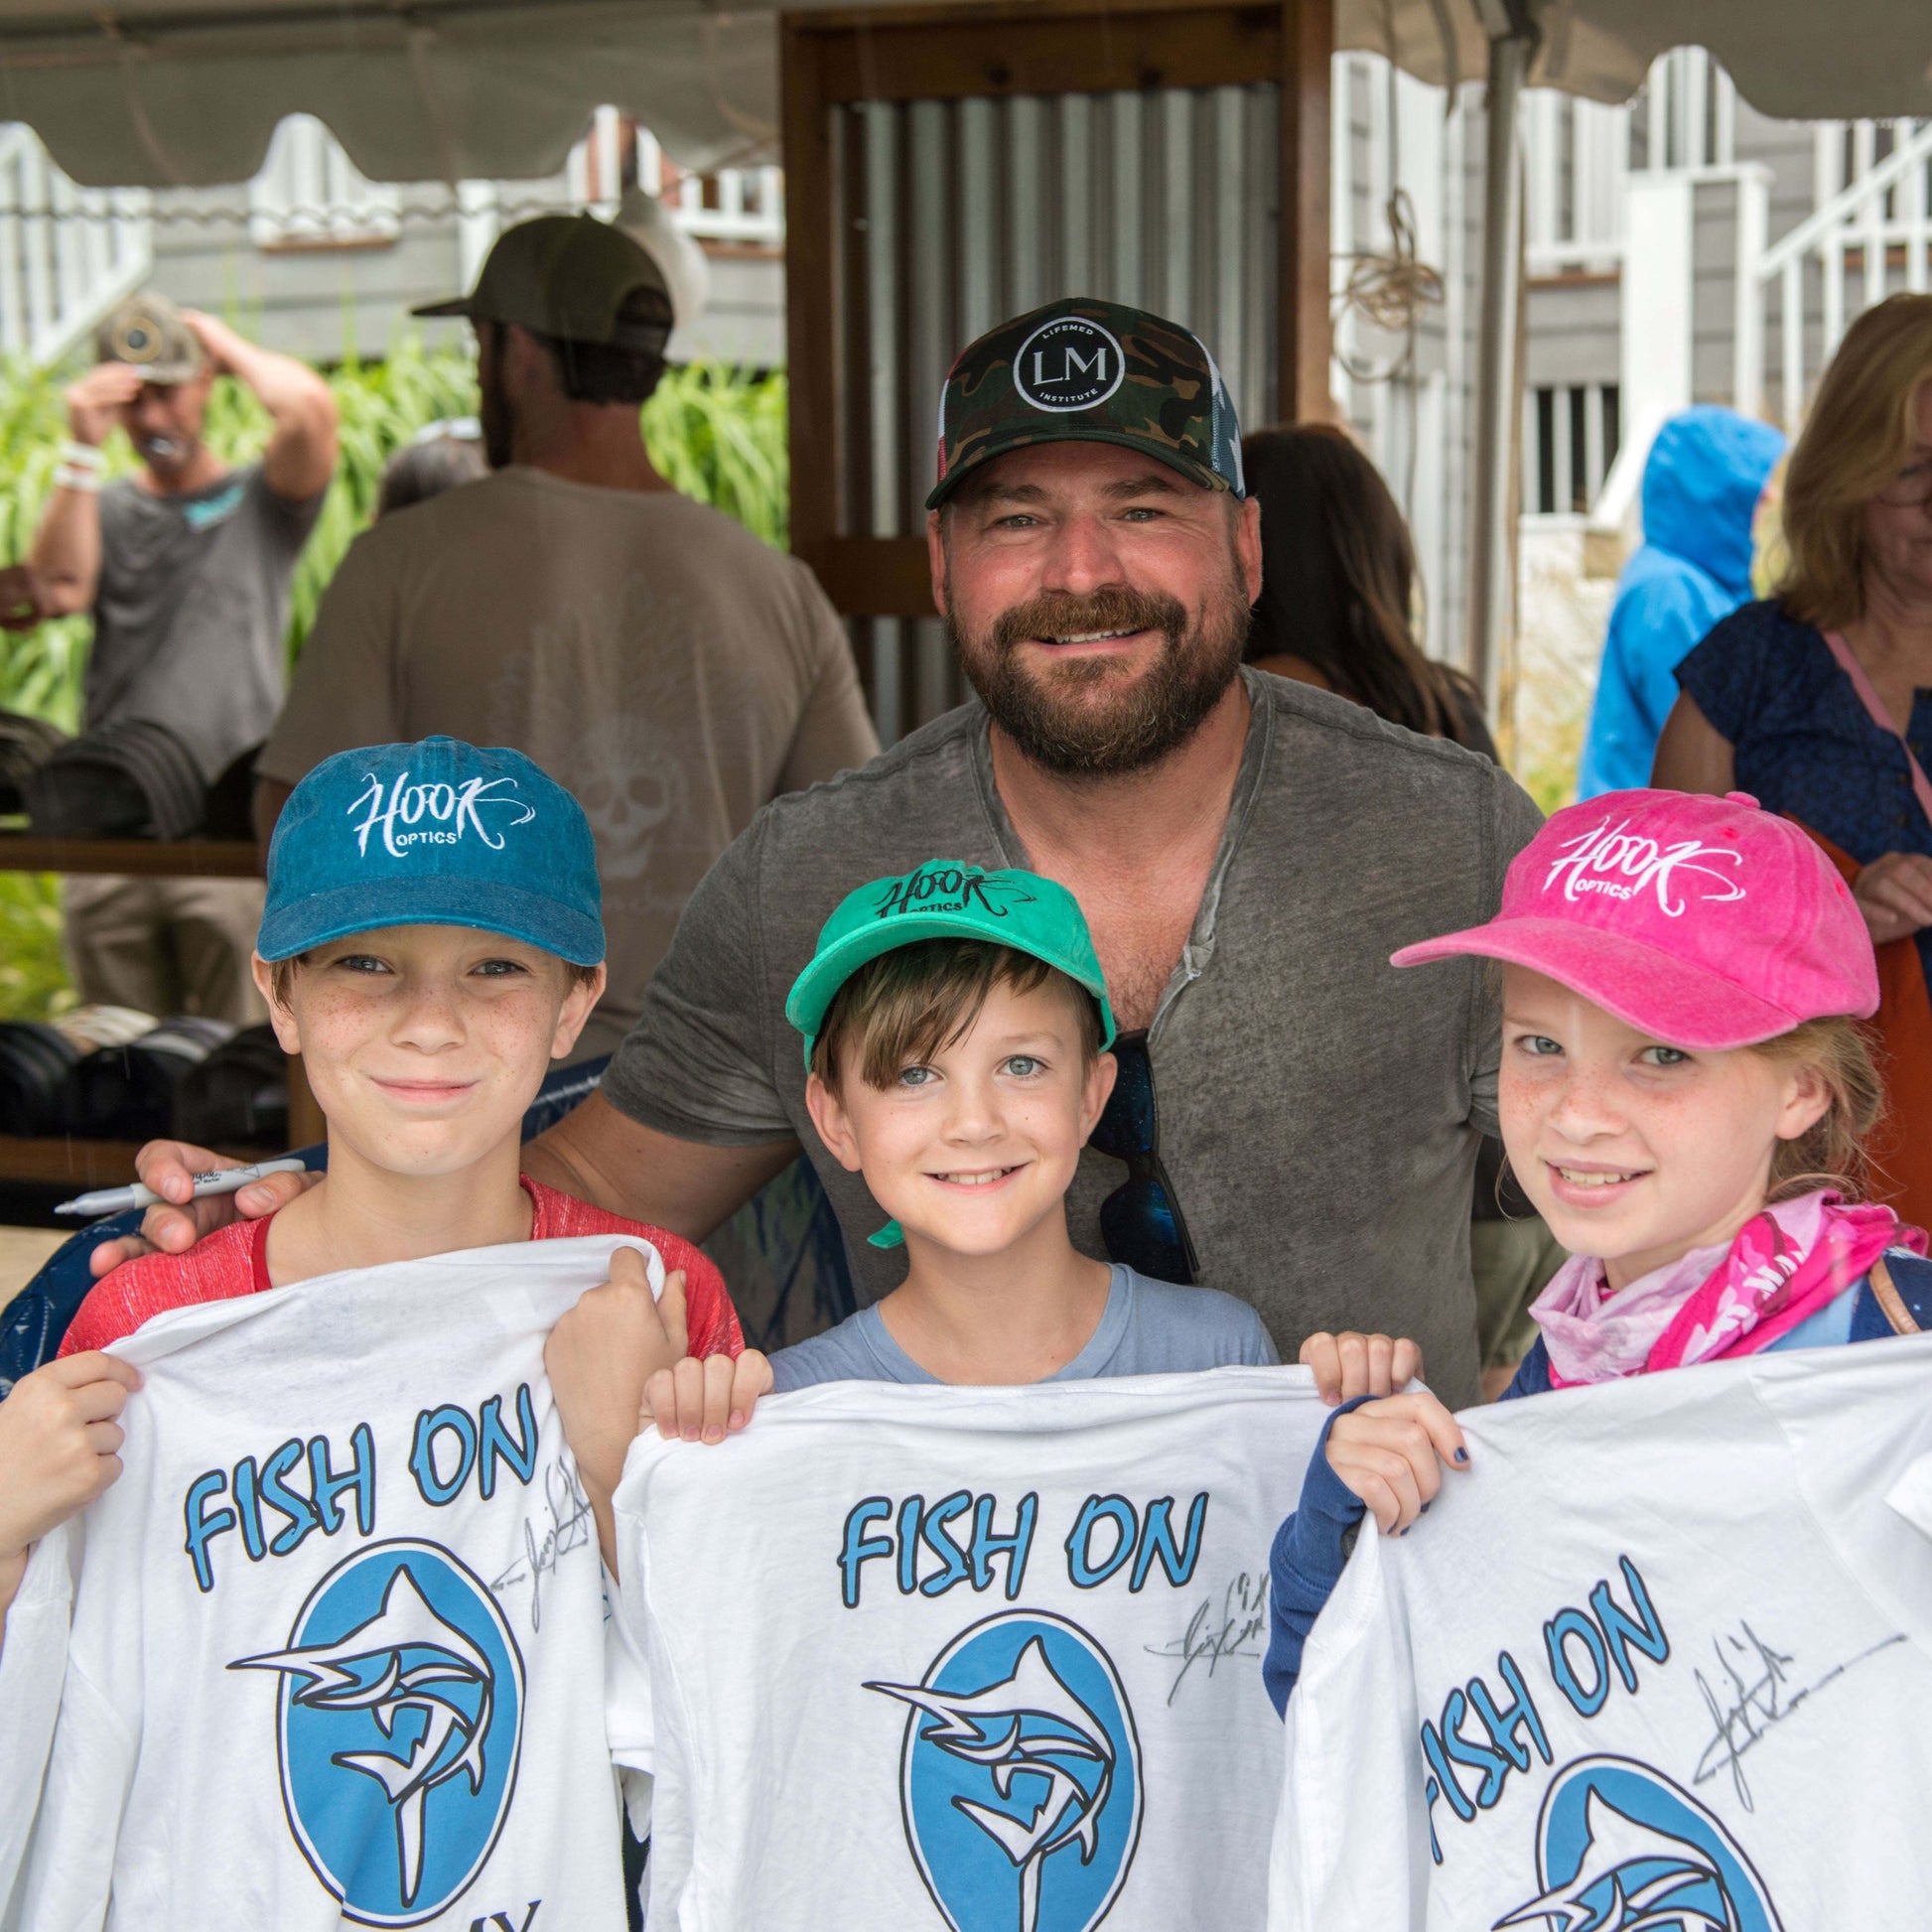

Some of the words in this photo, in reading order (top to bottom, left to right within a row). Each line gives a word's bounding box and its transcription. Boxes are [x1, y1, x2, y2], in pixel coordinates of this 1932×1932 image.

[1042, 324, 1094, 340] LIFEMED
[1033, 347, 1107, 386] LM
[1039, 387, 1098, 403] INSTITUTE
[347, 771, 536, 858] HOOK
[395, 831, 458, 846] OPTICS
[1543, 815, 1746, 917] HOOK
[1575, 878, 1632, 900] OPTICS
[185, 1422, 376, 1593] FISH
[408, 1383, 539, 1507] ON
[836, 1489, 1038, 1608] FISH
[1064, 1491, 1210, 1593] ON
[1543, 1554, 1671, 1718] ON
